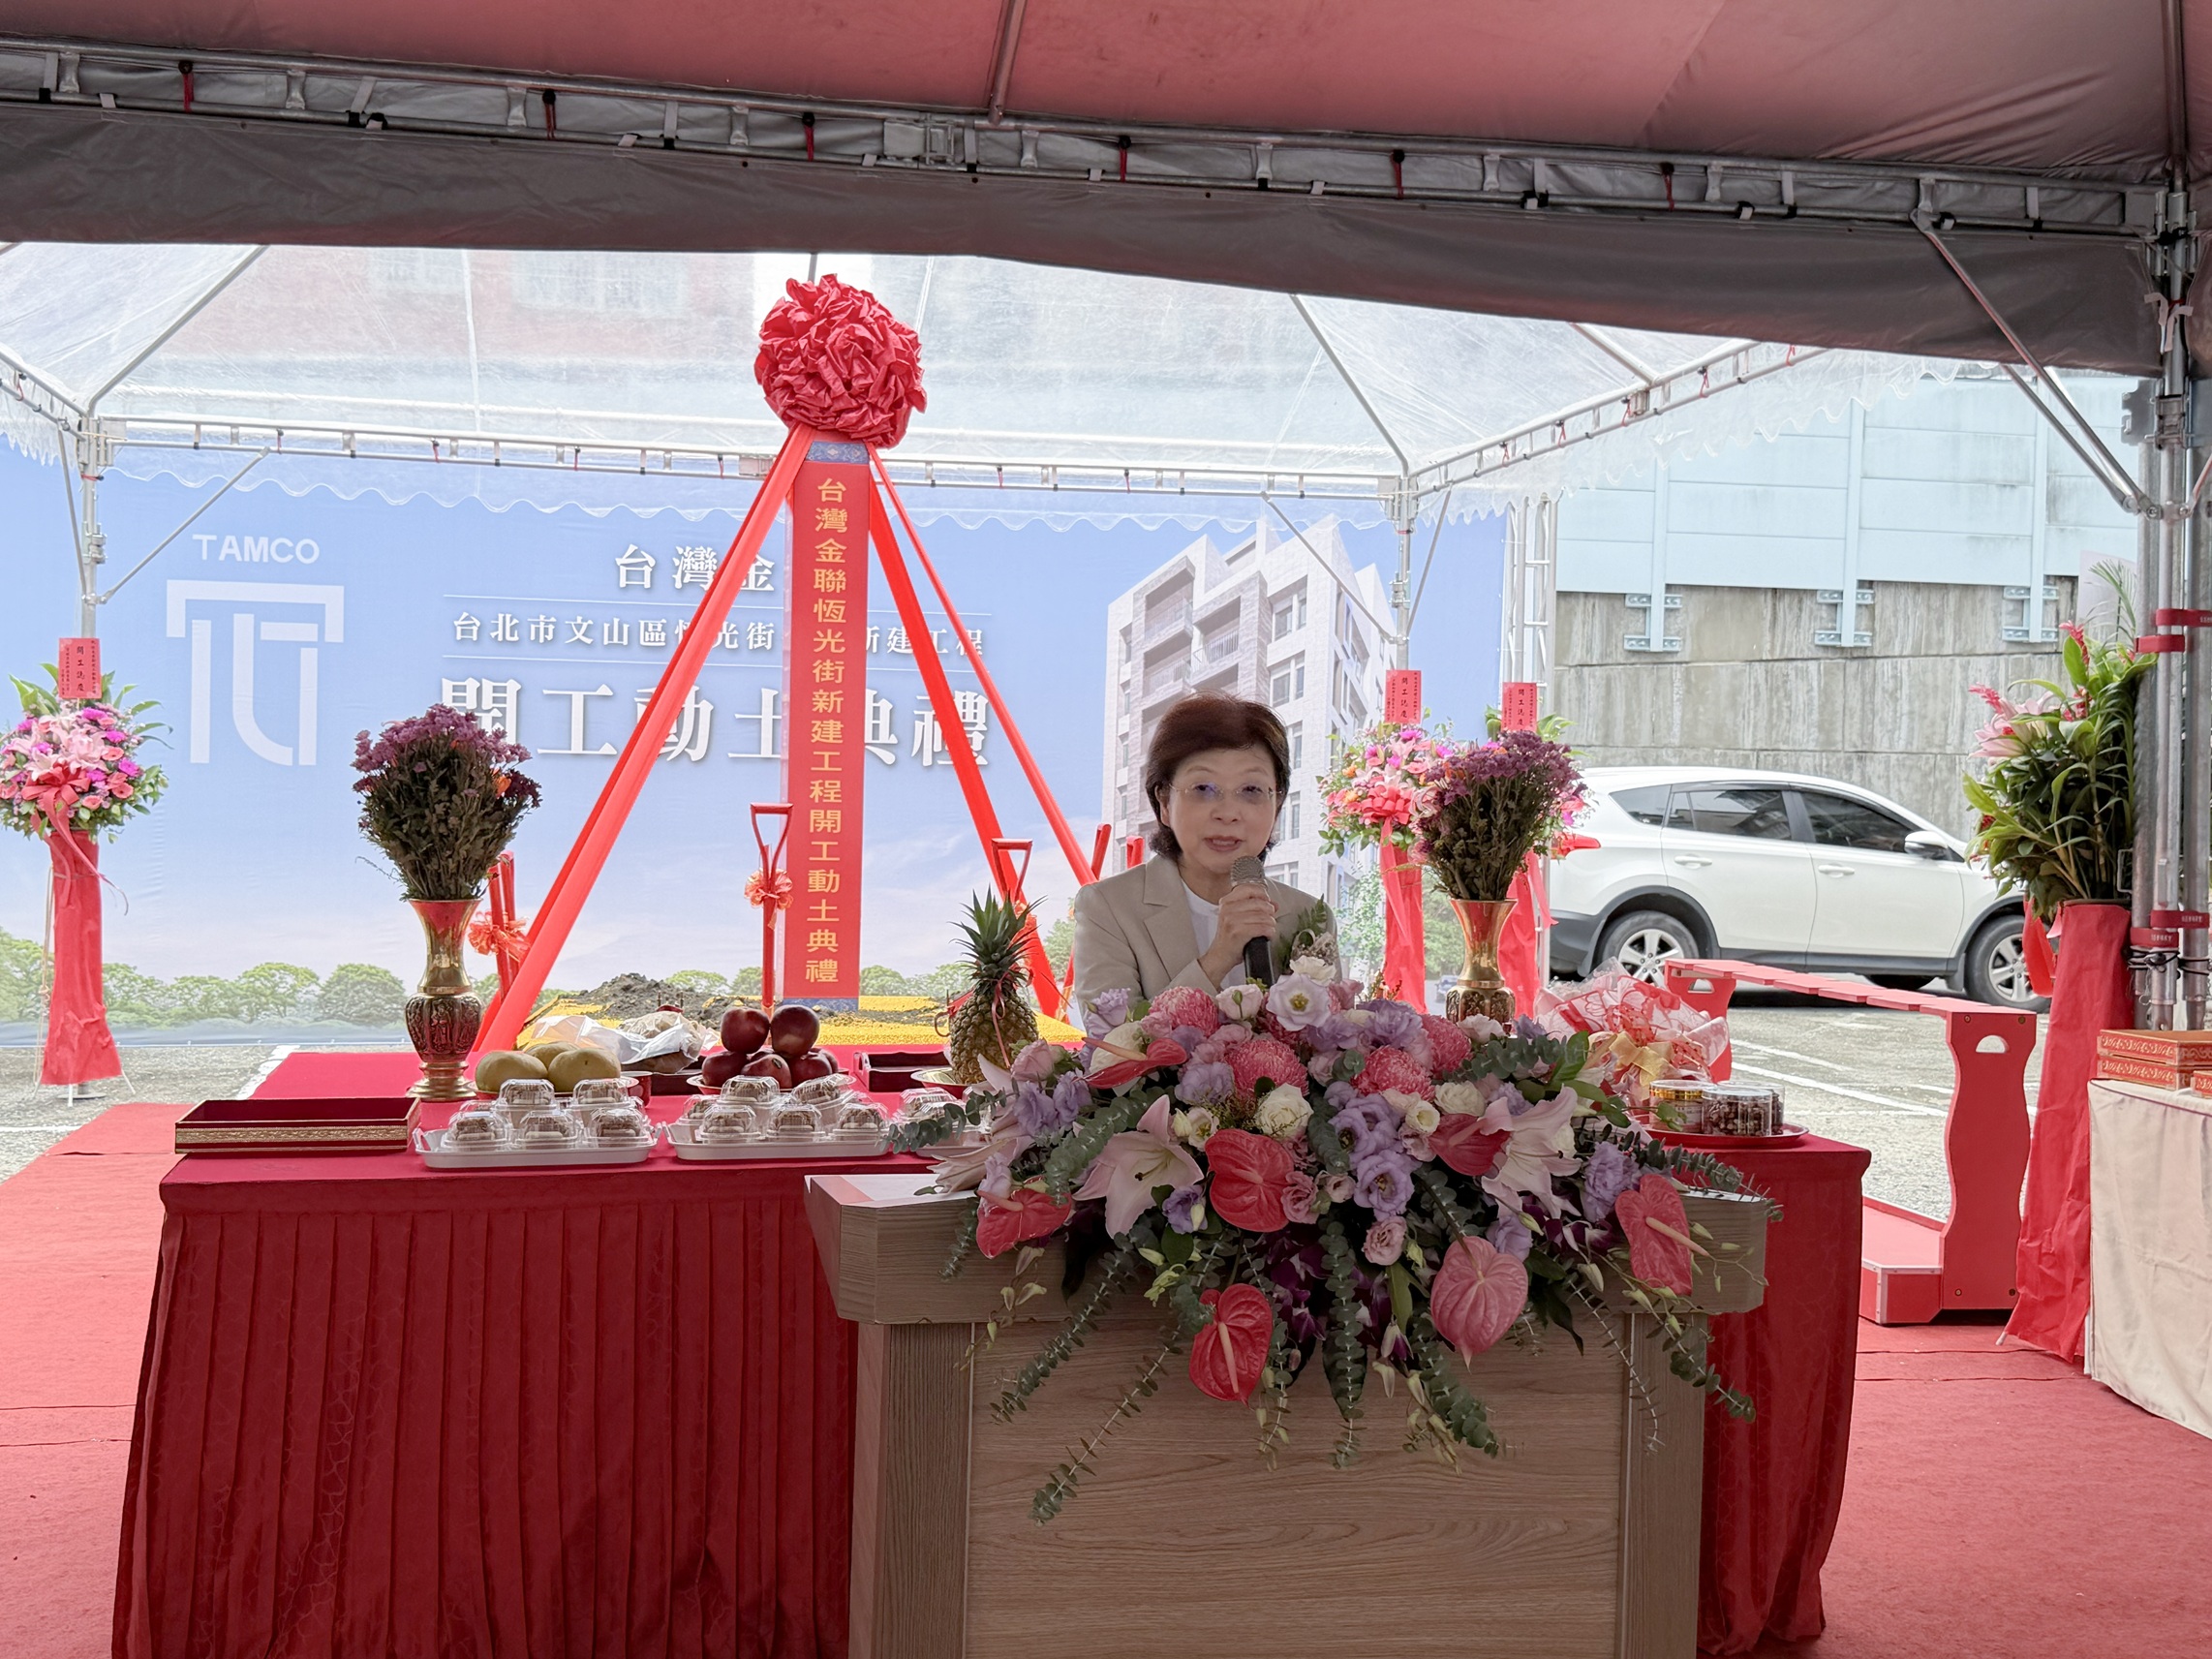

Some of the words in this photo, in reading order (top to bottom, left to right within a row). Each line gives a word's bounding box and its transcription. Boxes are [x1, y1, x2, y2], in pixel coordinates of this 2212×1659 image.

[192, 533, 321, 565] TAMCO
[805, 477, 848, 984] 台灣金聯恆光街新建工程開工動土典禮
